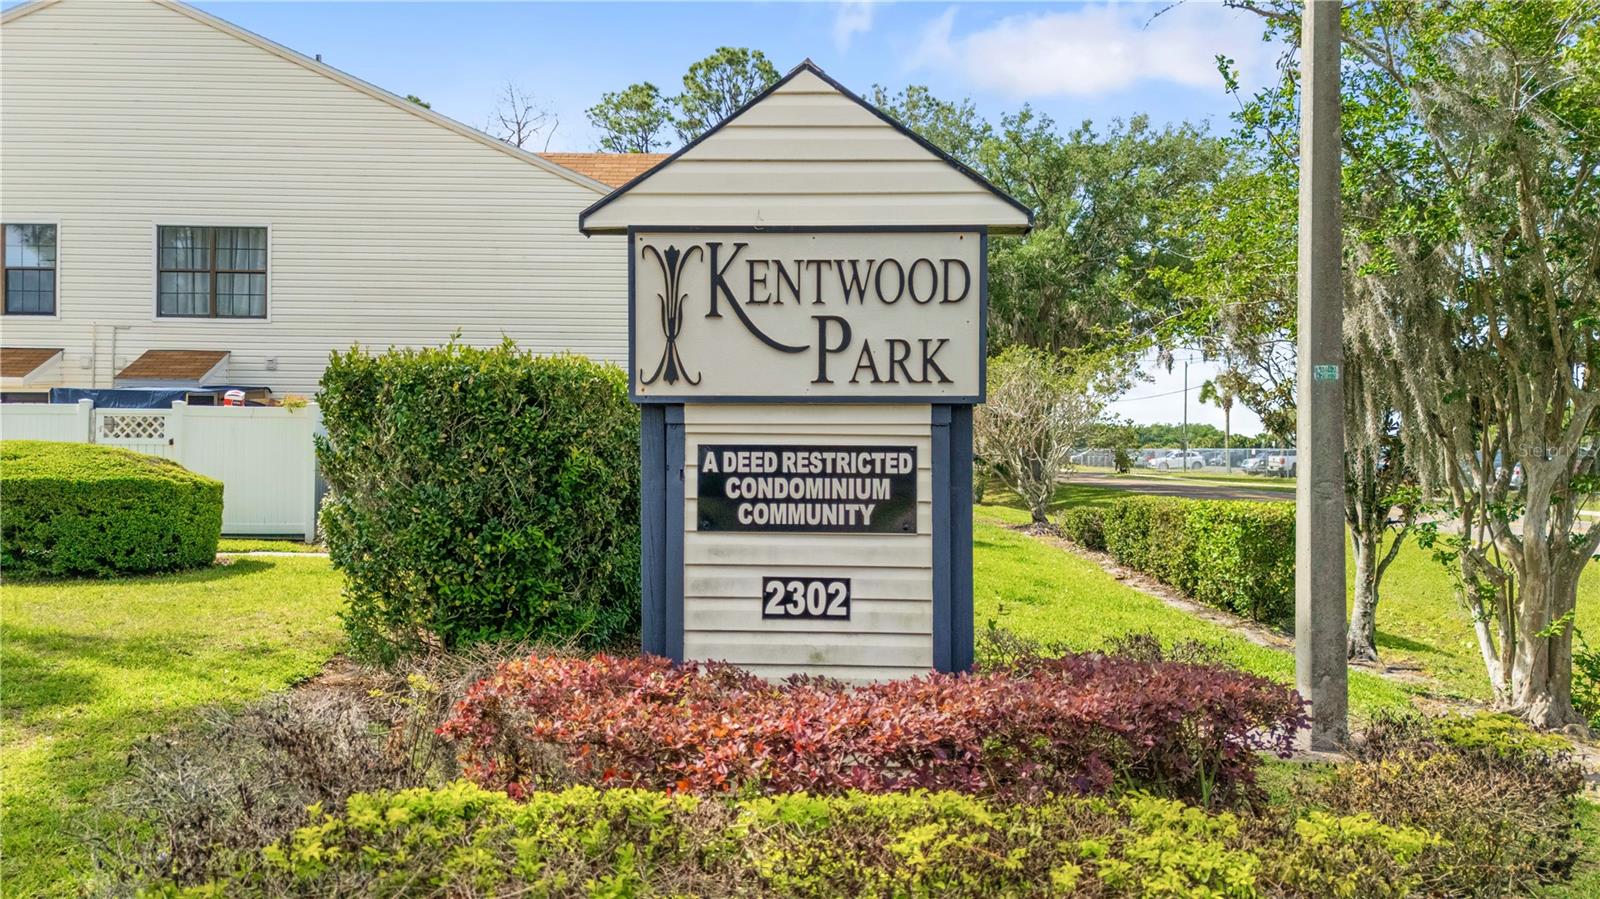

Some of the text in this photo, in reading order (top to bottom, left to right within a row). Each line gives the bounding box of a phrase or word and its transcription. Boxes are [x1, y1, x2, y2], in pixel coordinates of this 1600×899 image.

[705, 242, 971, 353] KENTWOOD
[811, 315, 954, 384] PARK
[702, 452, 913, 474] A DEED RESTRICTED
[725, 477, 891, 500] CONDOMINIUM
[738, 503, 876, 526] COMMUNITY
[764, 580, 848, 616] 2302
